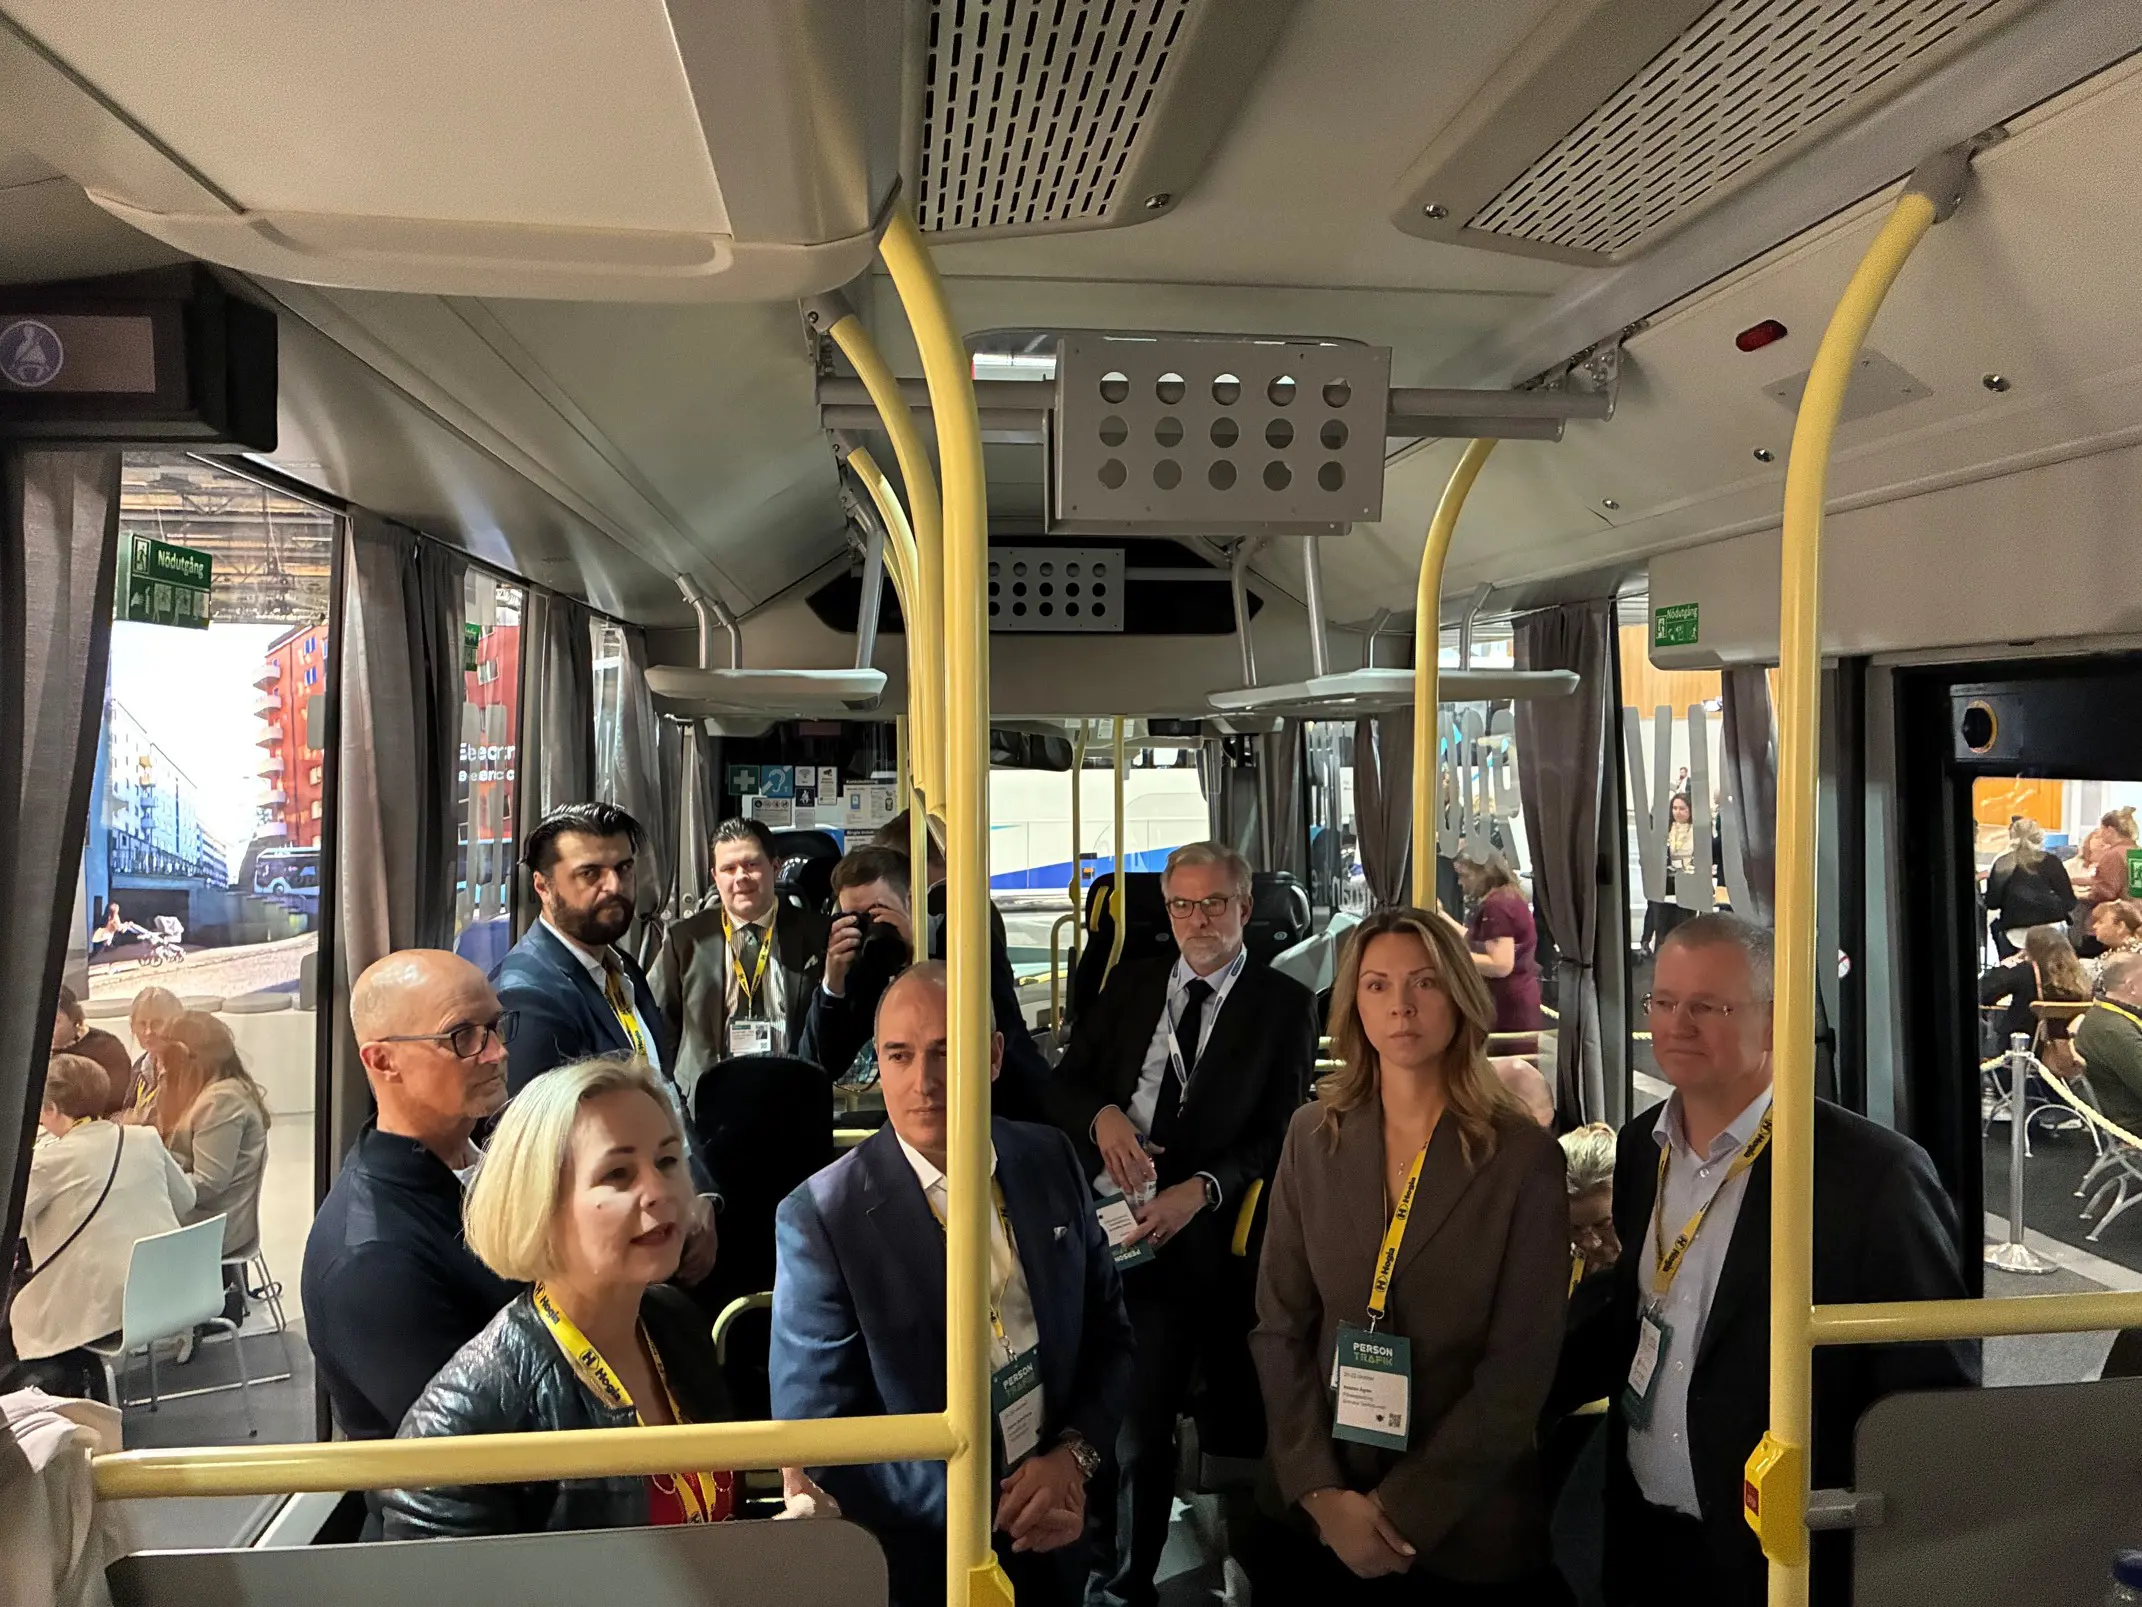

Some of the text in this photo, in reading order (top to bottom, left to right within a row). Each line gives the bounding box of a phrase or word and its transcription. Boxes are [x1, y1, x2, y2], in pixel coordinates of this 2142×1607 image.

[158, 550, 204, 579] Nödutgång
[1403, 1177, 1416, 1203] Hogia
[1381, 1247, 1395, 1275] Hogia
[1353, 1342, 1393, 1356] PERSON
[1354, 1352, 1393, 1366] TRAFIK
[595, 1367, 621, 1401] Hogia
[1003, 1362, 1034, 1390] PERSON
